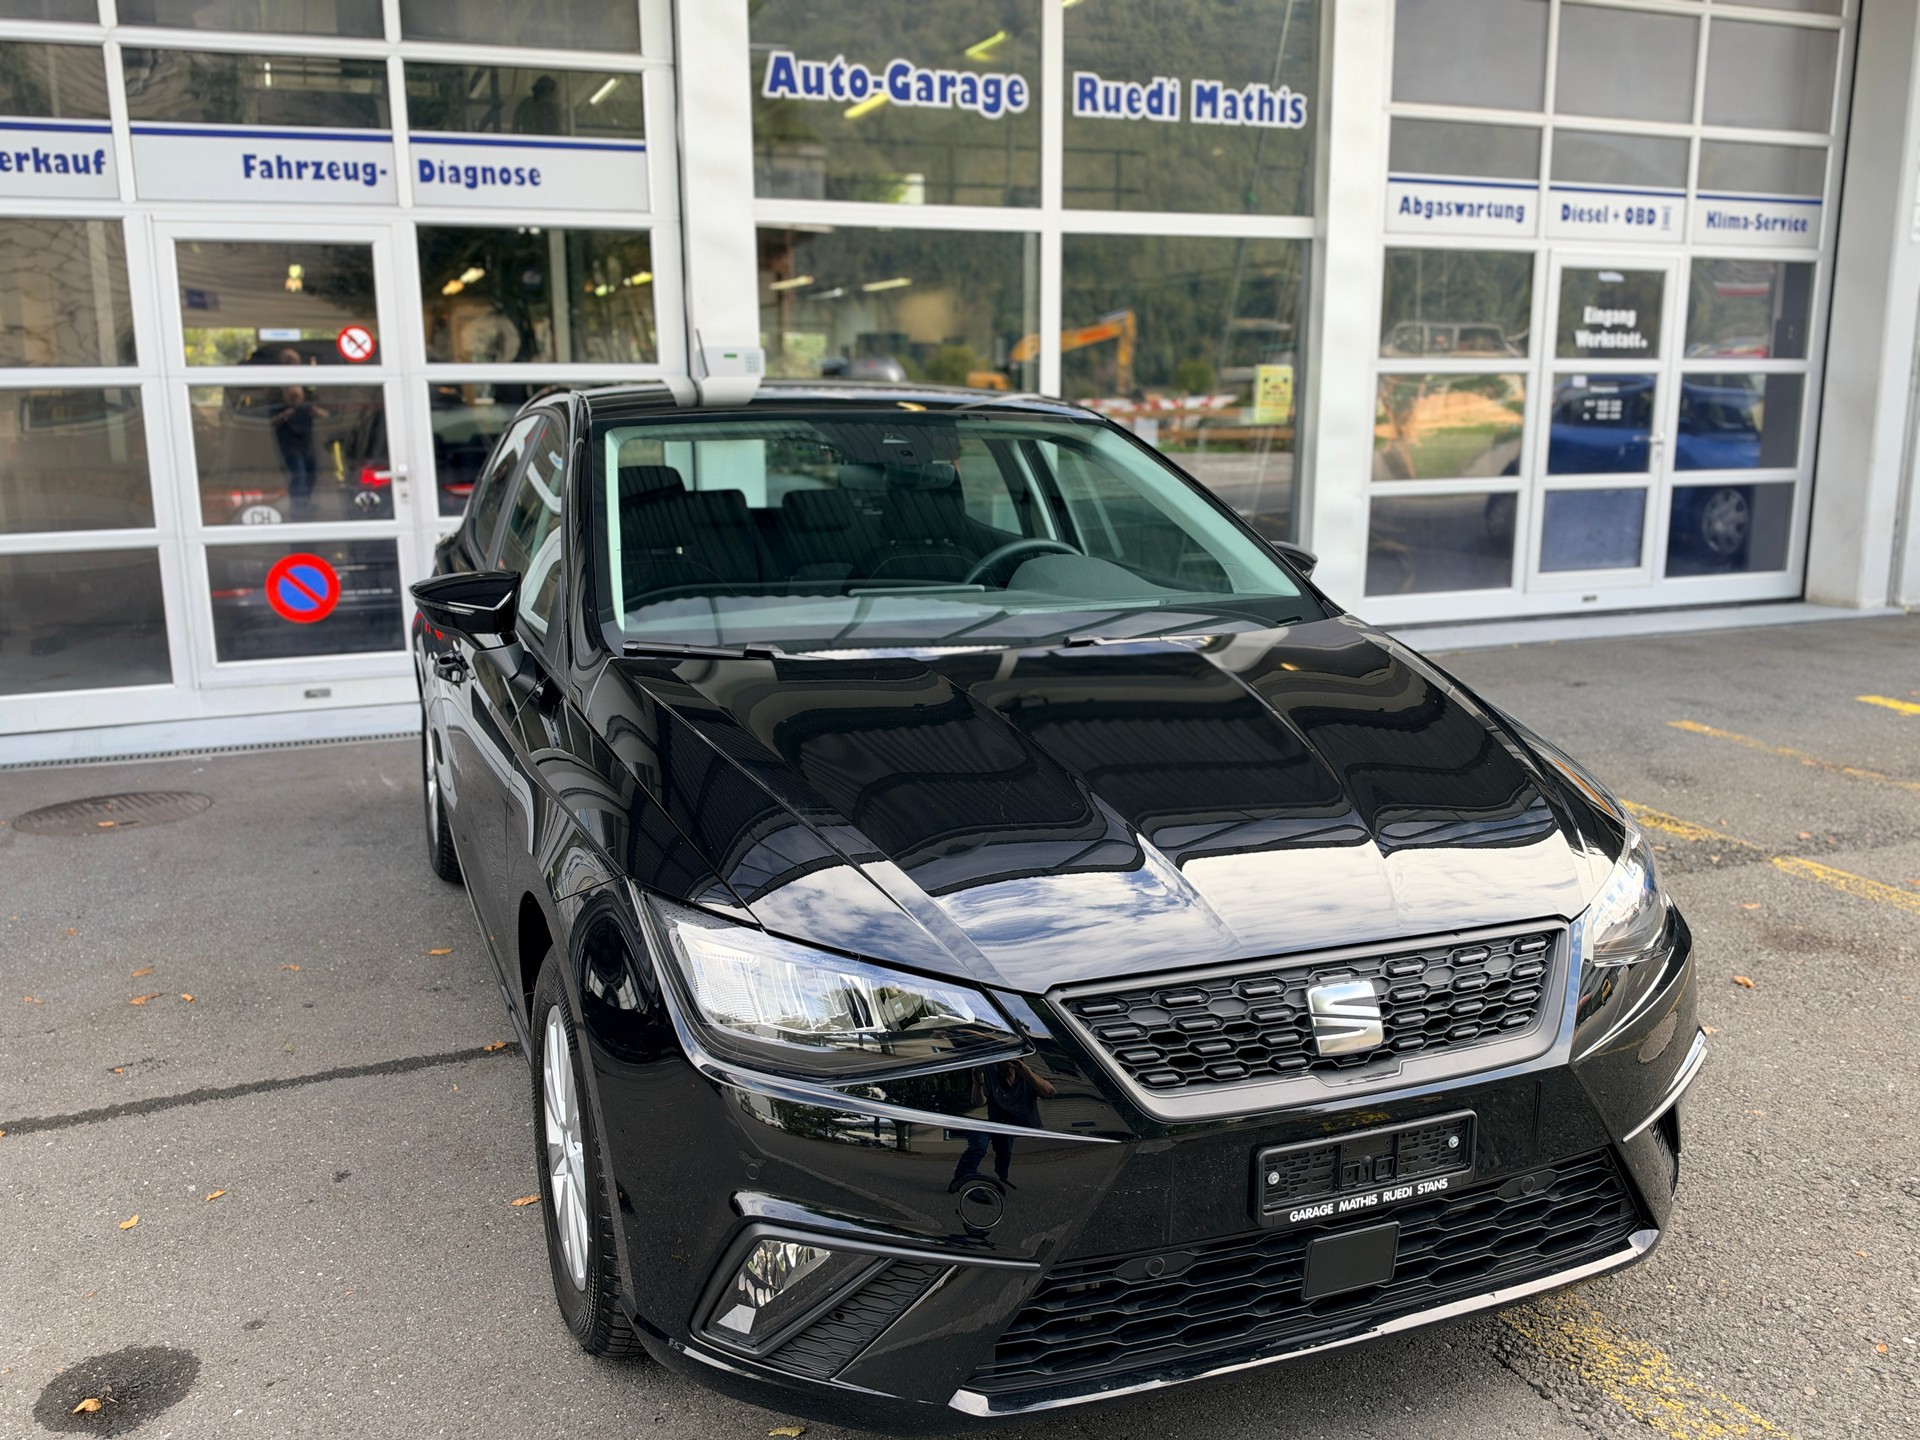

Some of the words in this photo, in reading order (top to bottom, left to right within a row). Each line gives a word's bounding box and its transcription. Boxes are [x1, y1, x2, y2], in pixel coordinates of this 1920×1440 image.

[764, 52, 1029, 118] Auto-Garage
[1074, 73, 1180, 121] Ruedi
[1191, 80, 1307, 128] Mathis
[242, 154, 388, 187] Fahrzeug-
[418, 158, 542, 189] Diagnose
[1399, 196, 1526, 223] Abgaswartung
[1560, 203, 1609, 224] Diesel
[1625, 207, 1657, 226] OBD
[1706, 210, 1808, 233] Klima-Service
[1583, 305, 1637, 328] Eingang
[1289, 1203, 1334, 1223] GARAGE
[1338, 1193, 1378, 1213] MATHIS
[1382, 1186, 1413, 1204] RUEDI
[1417, 1178, 1448, 1195] STANS
